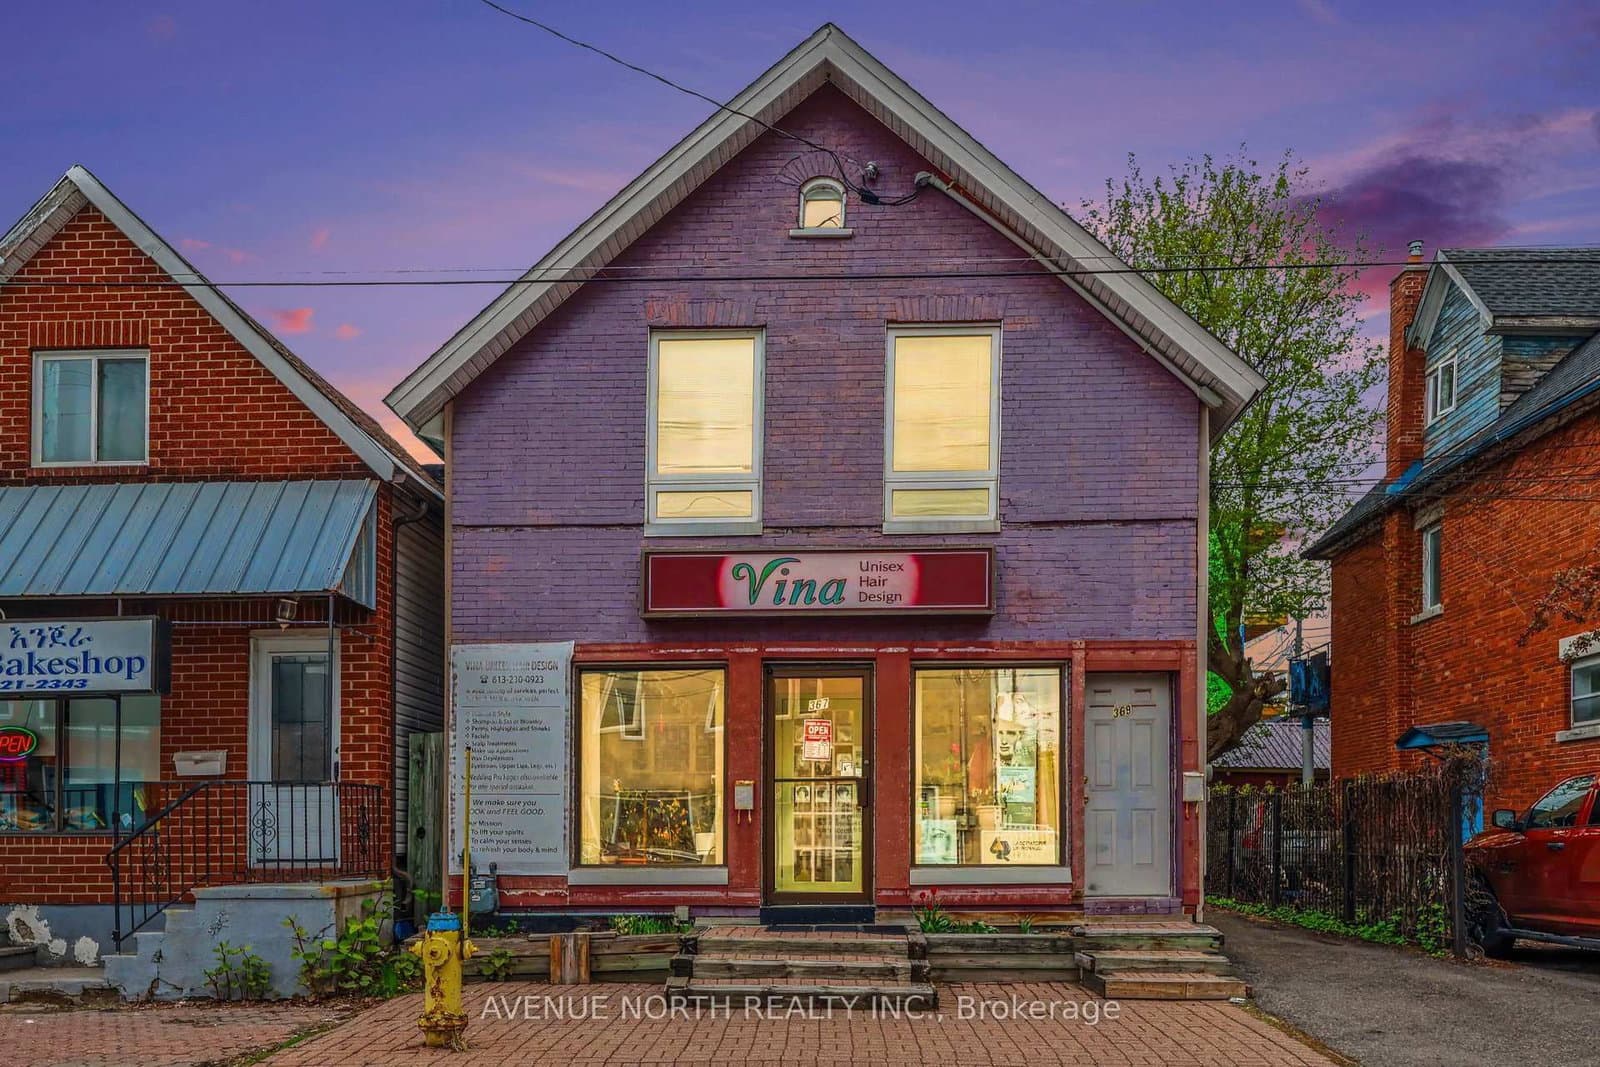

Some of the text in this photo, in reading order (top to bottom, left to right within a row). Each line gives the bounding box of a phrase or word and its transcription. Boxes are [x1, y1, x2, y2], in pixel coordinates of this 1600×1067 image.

[859, 560, 904, 573] Unisex
[732, 557, 847, 605] Vina
[859, 575, 888, 588] Hair
[858, 590, 902, 604] Design
[531, 661, 559, 671] DESIGN
[809, 699, 828, 710] 367
[1113, 705, 1131, 718] 369
